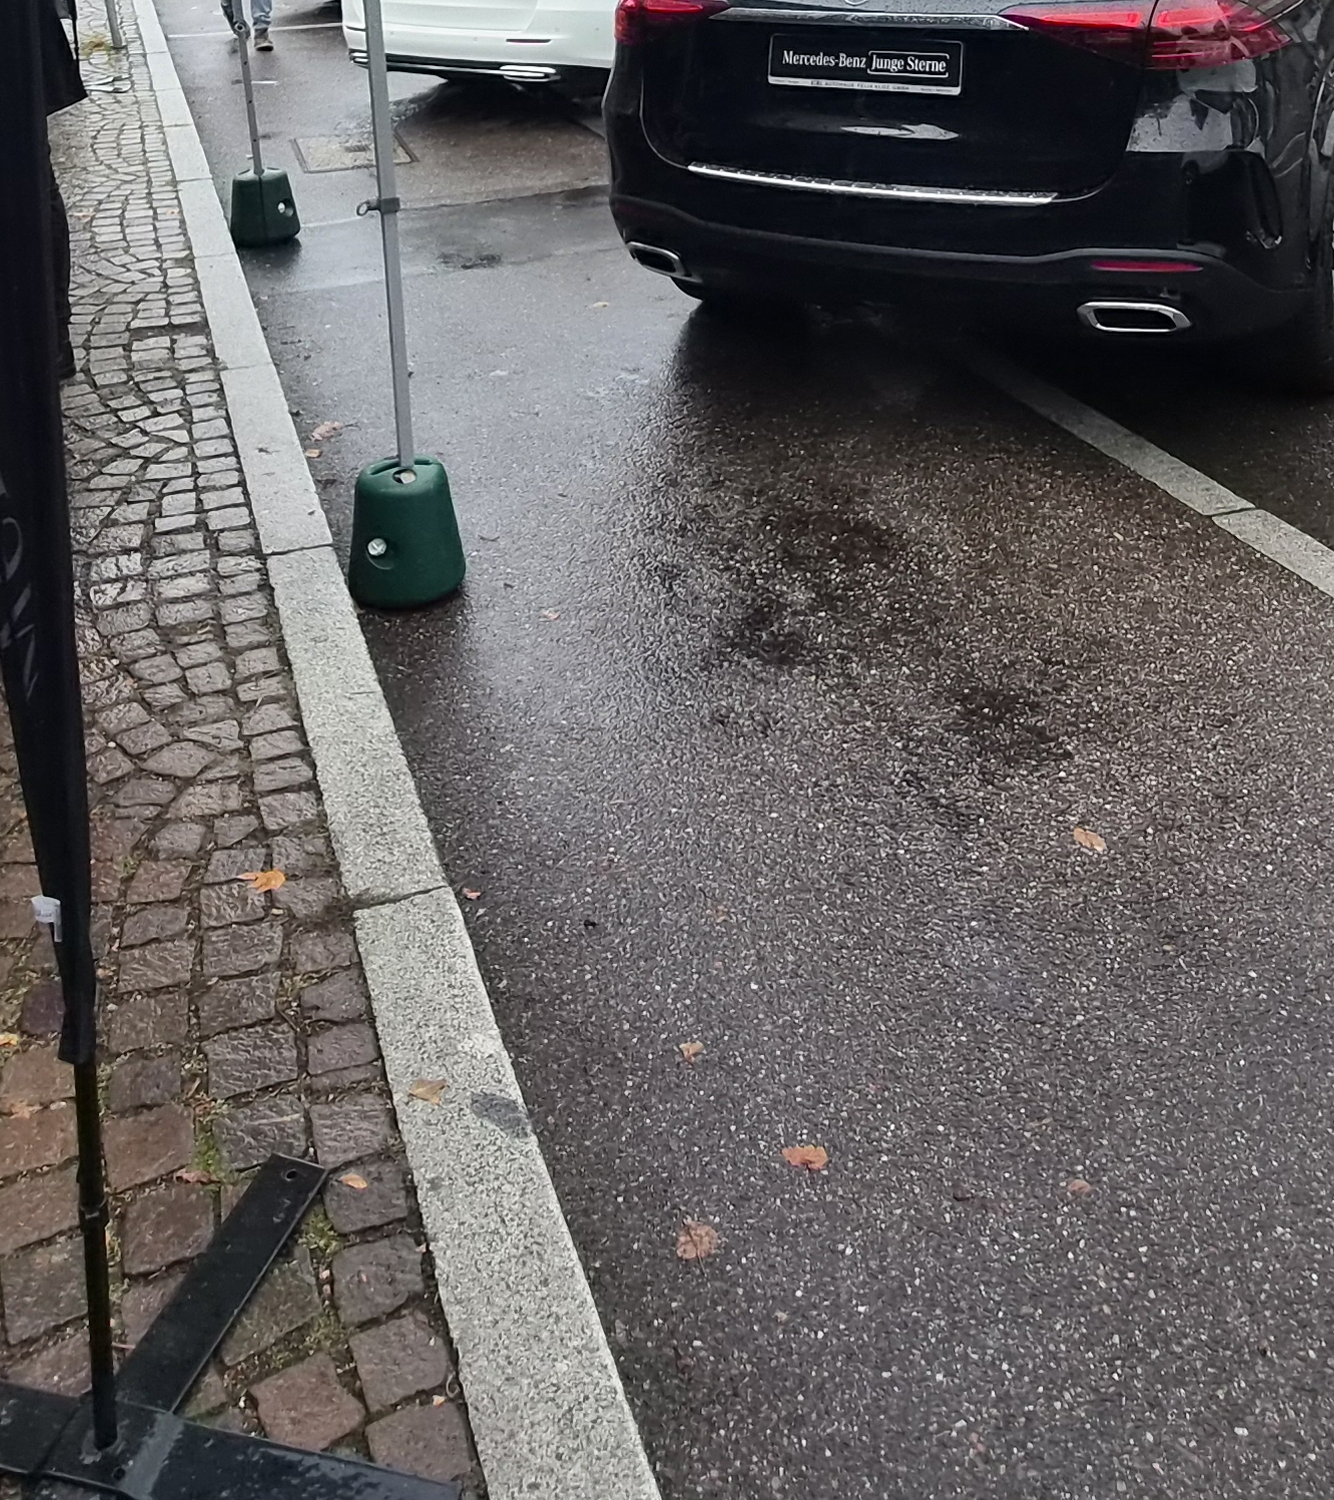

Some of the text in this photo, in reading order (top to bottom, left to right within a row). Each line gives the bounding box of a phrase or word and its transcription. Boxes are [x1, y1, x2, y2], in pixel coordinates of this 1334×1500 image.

[782, 50, 947, 73] Mercedes-Benz Junge Sterne
